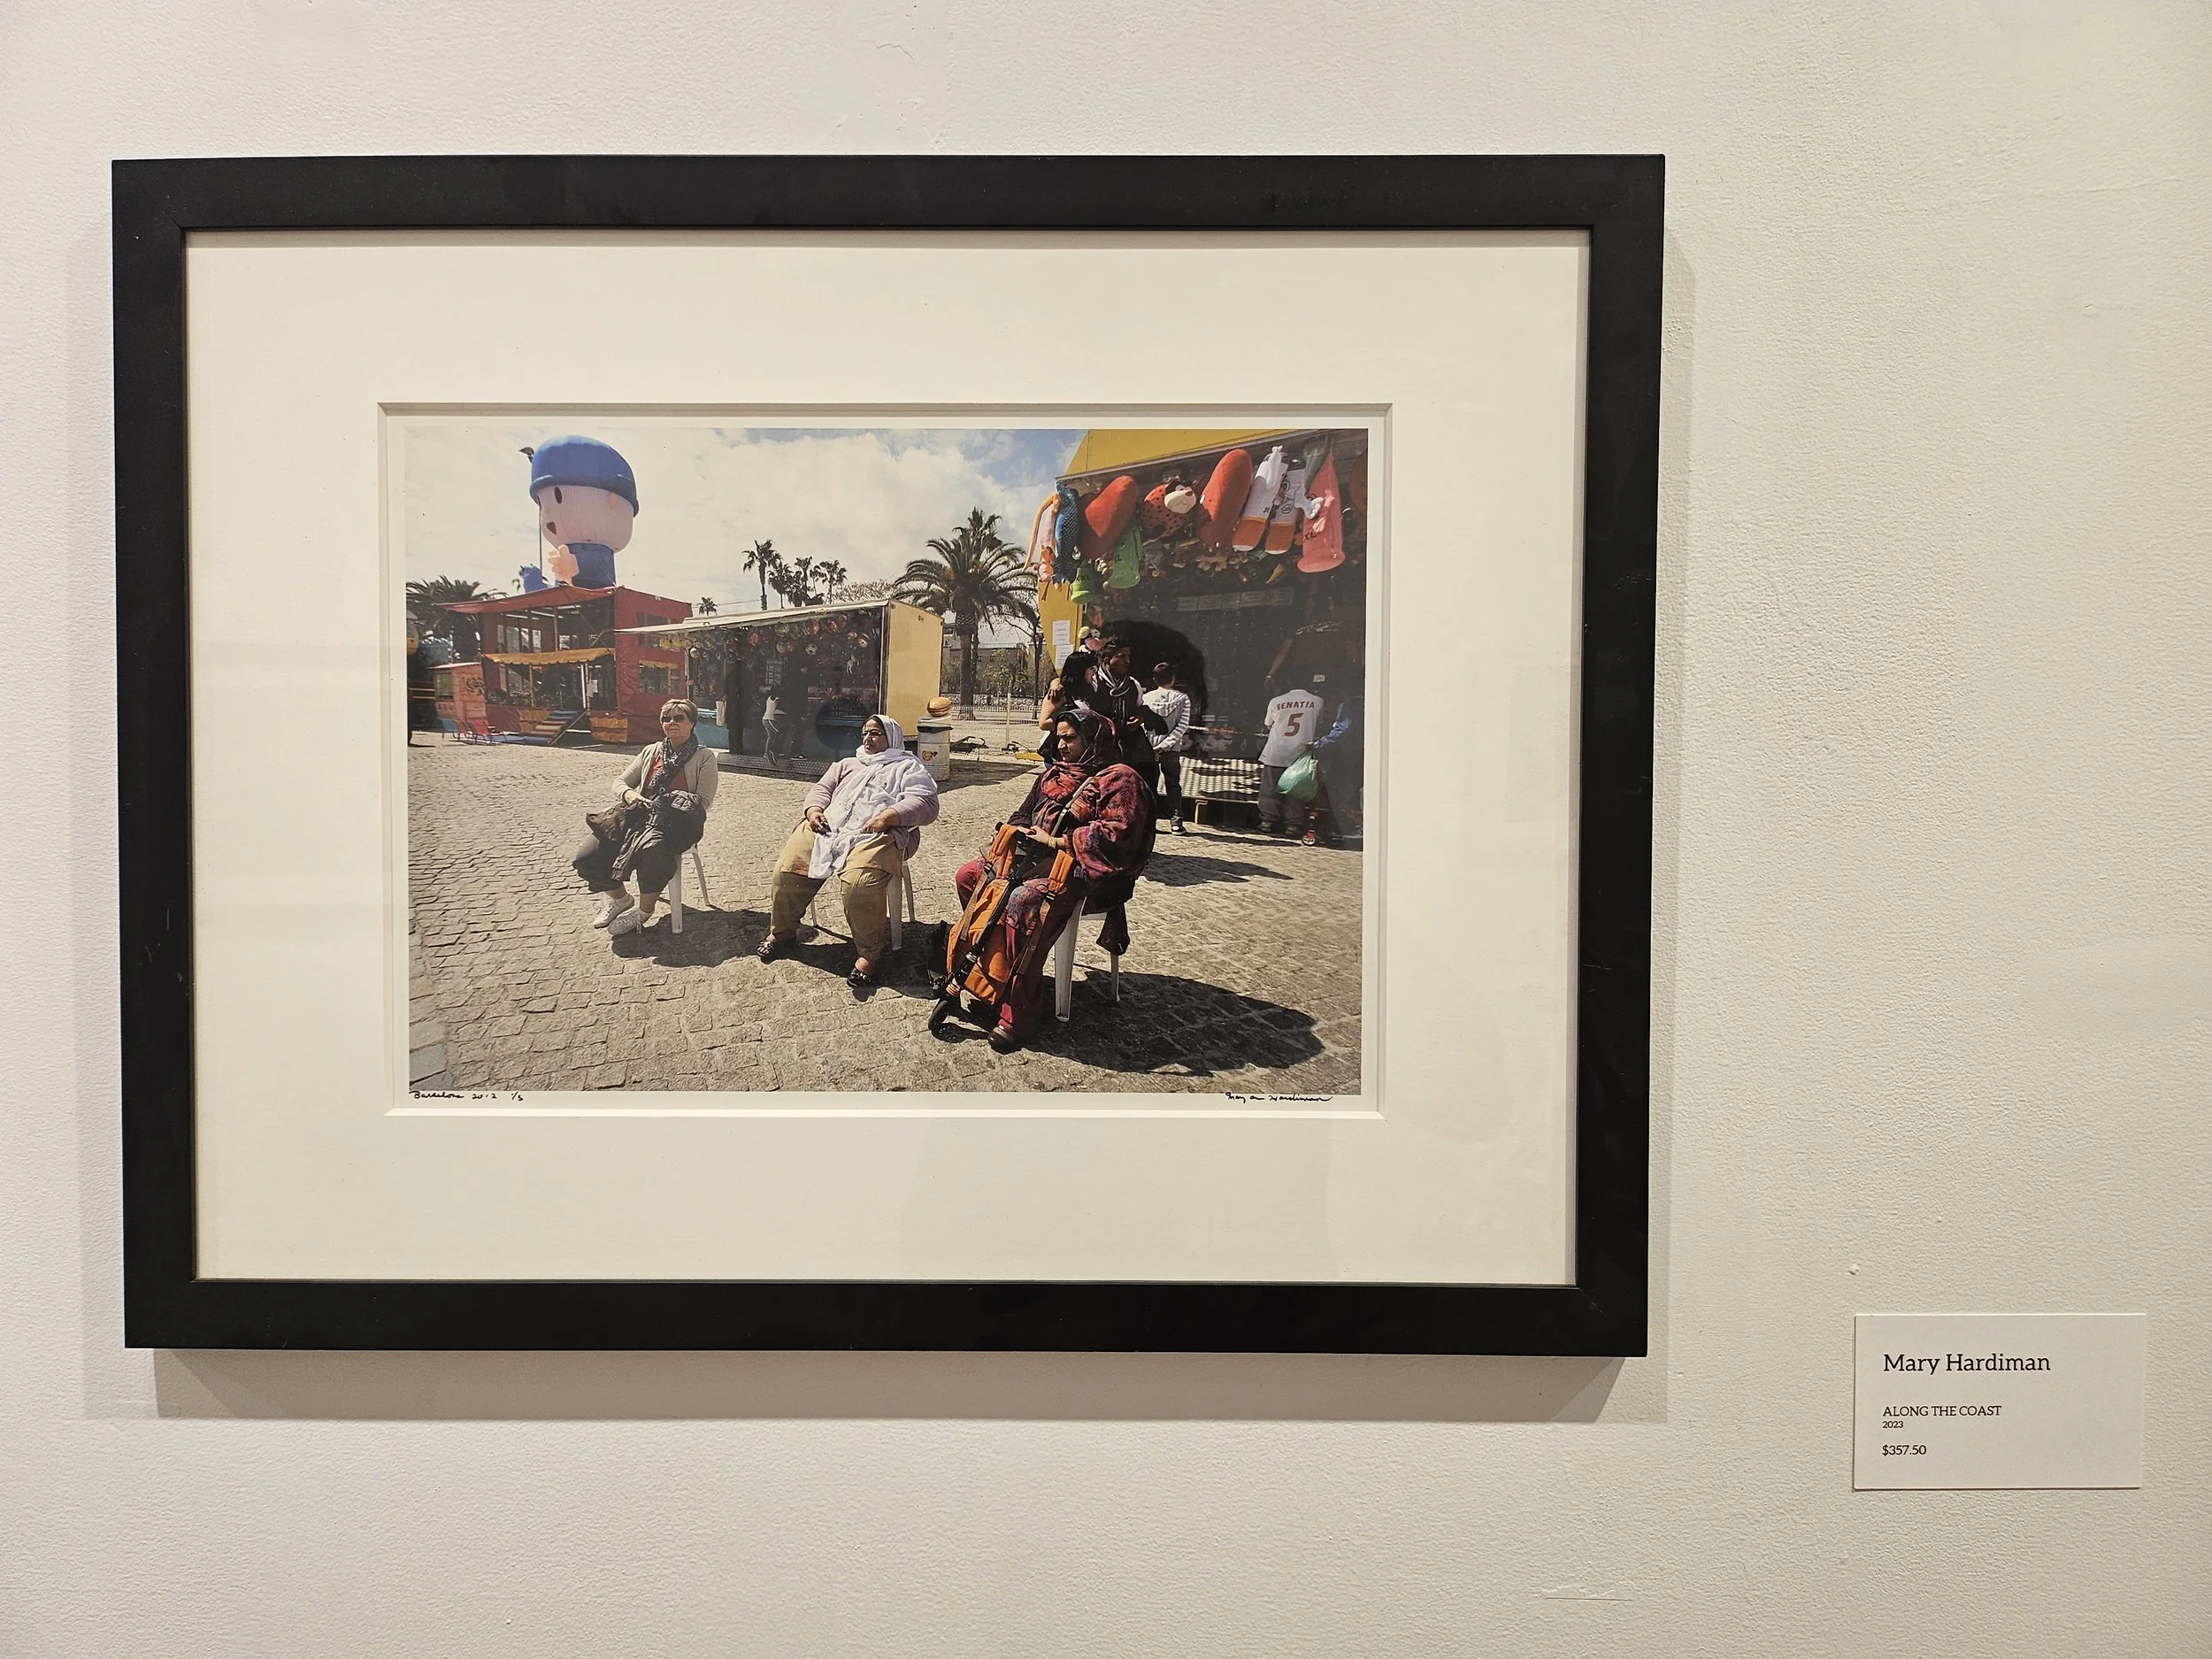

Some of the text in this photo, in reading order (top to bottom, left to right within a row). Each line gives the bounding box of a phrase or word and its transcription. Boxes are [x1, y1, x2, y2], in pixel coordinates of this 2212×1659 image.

[1284, 712, 1303, 736] 5
[1883, 1353, 2051, 1375] Mary Hardiman
[1882, 1405, 2002, 1417] ALONG THE COAST
[1882, 1420, 1904, 1429] 2023
[1881, 1444, 1927, 1456] $357.50
